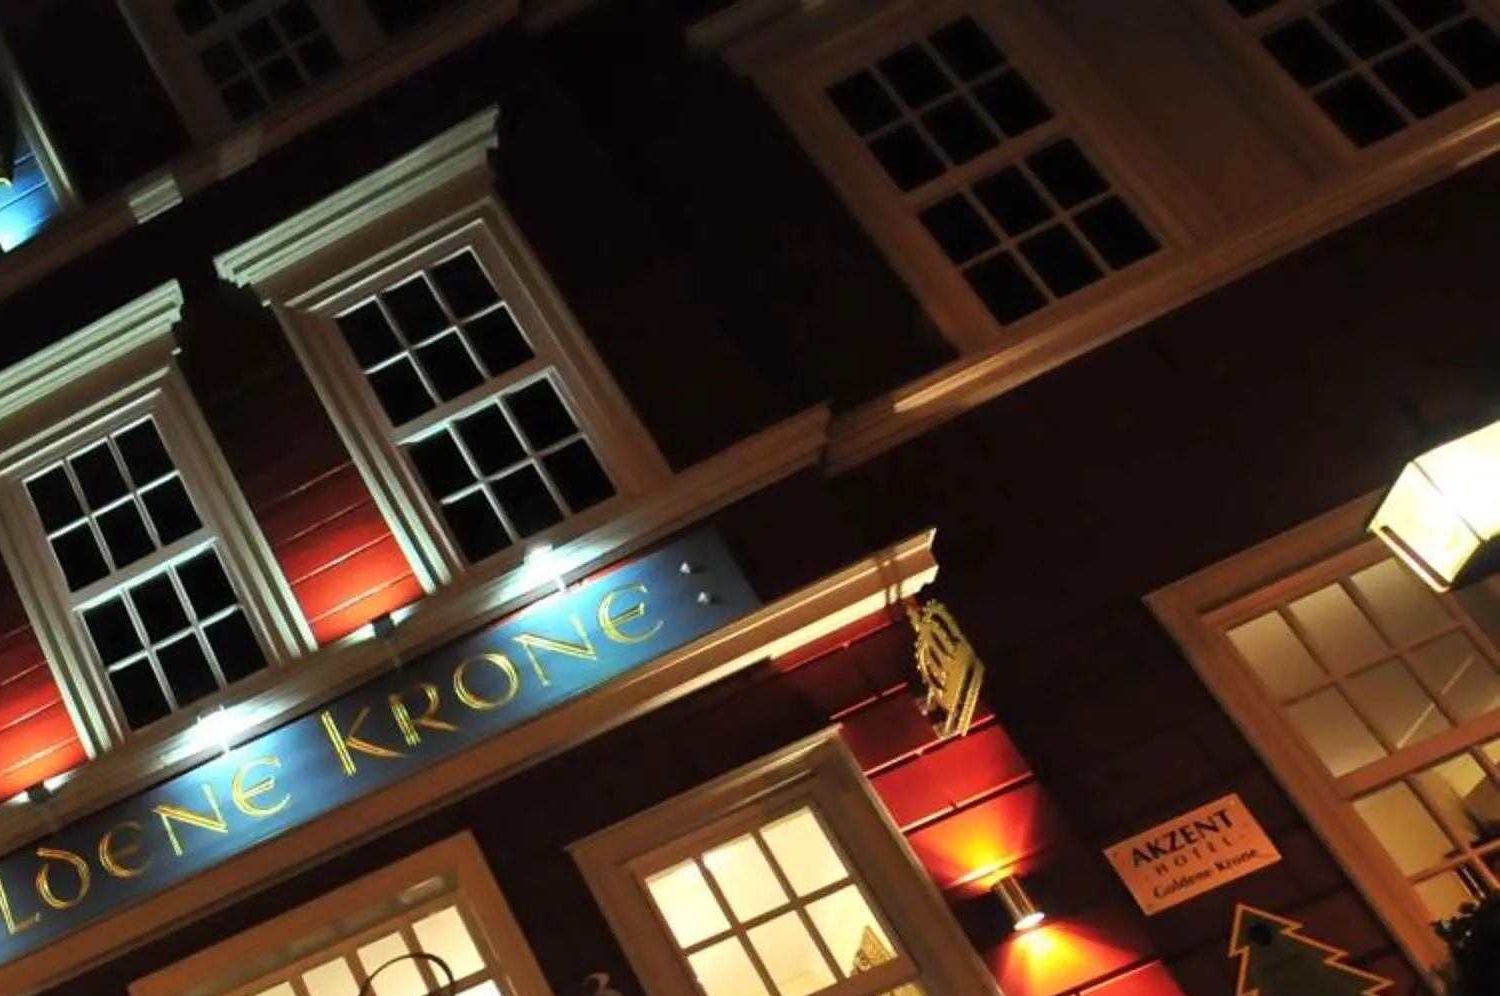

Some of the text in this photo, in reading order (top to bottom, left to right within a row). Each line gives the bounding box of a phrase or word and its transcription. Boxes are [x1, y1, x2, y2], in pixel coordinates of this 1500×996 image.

[321, 583, 665, 777] KRONE
[1131, 808, 1233, 868] AKZENT
[1214, 848, 1258, 874] Krone
